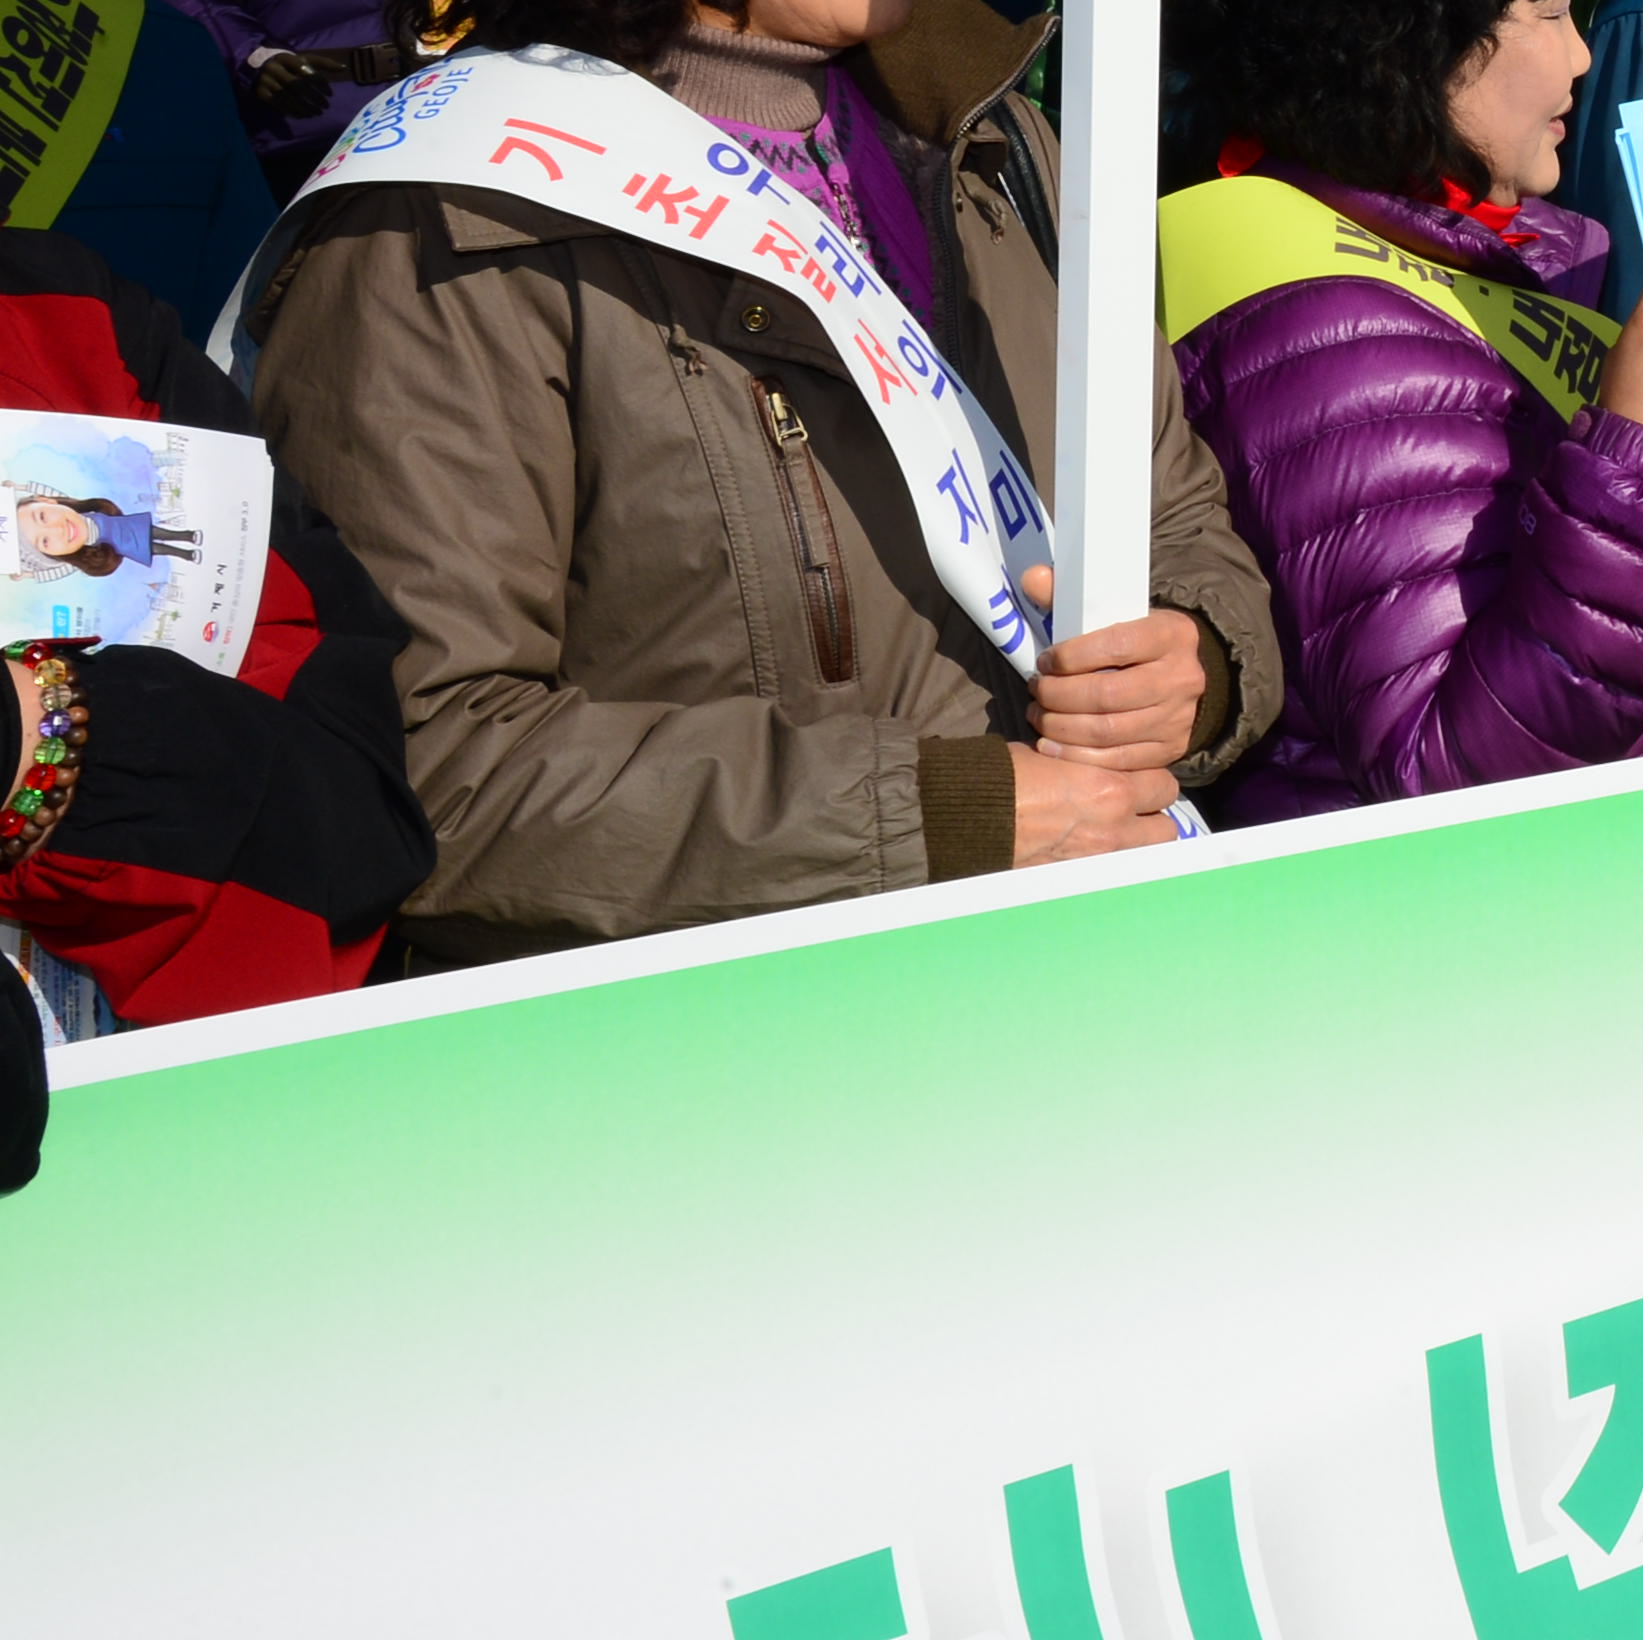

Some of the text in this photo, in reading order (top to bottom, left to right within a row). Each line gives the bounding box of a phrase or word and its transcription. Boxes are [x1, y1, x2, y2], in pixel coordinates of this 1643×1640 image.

[413, 65, 473, 120] GEOJE
[489, 117, 918, 405] 기초질서
[706, 140, 962, 400] 우리의
